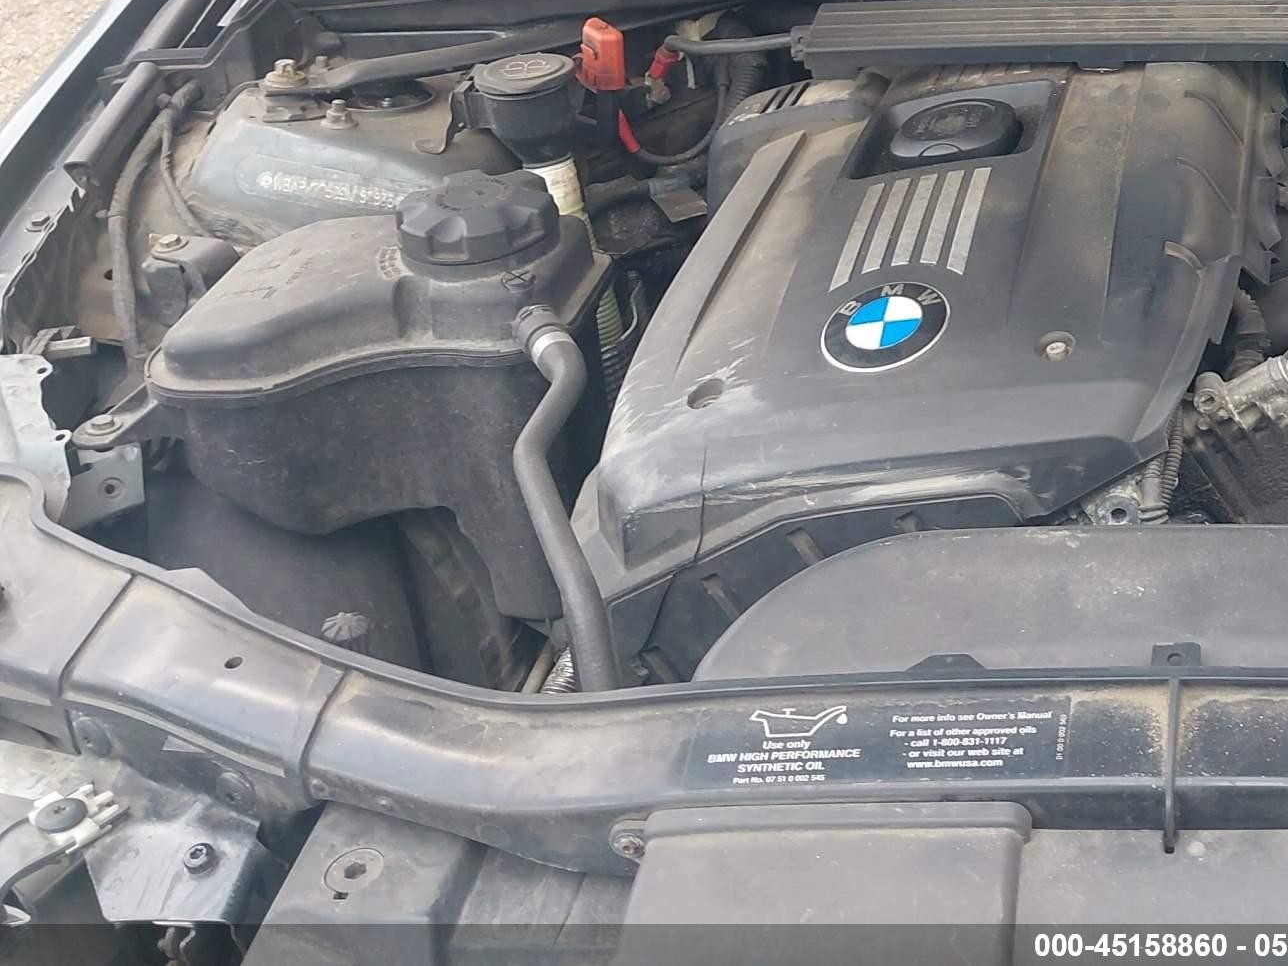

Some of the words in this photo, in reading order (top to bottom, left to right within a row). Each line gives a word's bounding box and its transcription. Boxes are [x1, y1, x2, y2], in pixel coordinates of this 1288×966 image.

[838, 283, 942, 317] BMW
[892, 715, 909, 723] For
[911, 715, 935, 723] more
[937, 714, 956, 722] info
[957, 714, 975, 722] see
[976, 712, 1016, 721] Owner's
[1017, 711, 1054, 720] Manual
[889, 729, 907, 738] For
[916, 728, 932, 737] list
[933, 728, 945, 736] of
[945, 728, 972, 736] other
[972, 726, 1018, 736] approved
[1018, 725, 1037, 735] oils
[762, 740, 785, 750] Use
[786, 739, 811, 750] only
[910, 738, 931, 747] call
[932, 737, 1008, 747] 1-800-831-1117
[707, 753, 738, 764] BMW
[739, 752, 769, 762] HIGH
[770, 748, 861, 761] PERFORMANCE
[922, 749, 946, 757] visit
[946, 749, 966, 757] our
[967, 747, 990, 756] web
[991, 747, 1012, 756] site
[1012, 747, 1024, 755] at
[737, 761, 804, 773] SYNTHETIC
[804, 761, 825, 771] OIL
[906, 759, 1004, 769] www.bmwusa.com
[765, 775, 776, 783] 07
